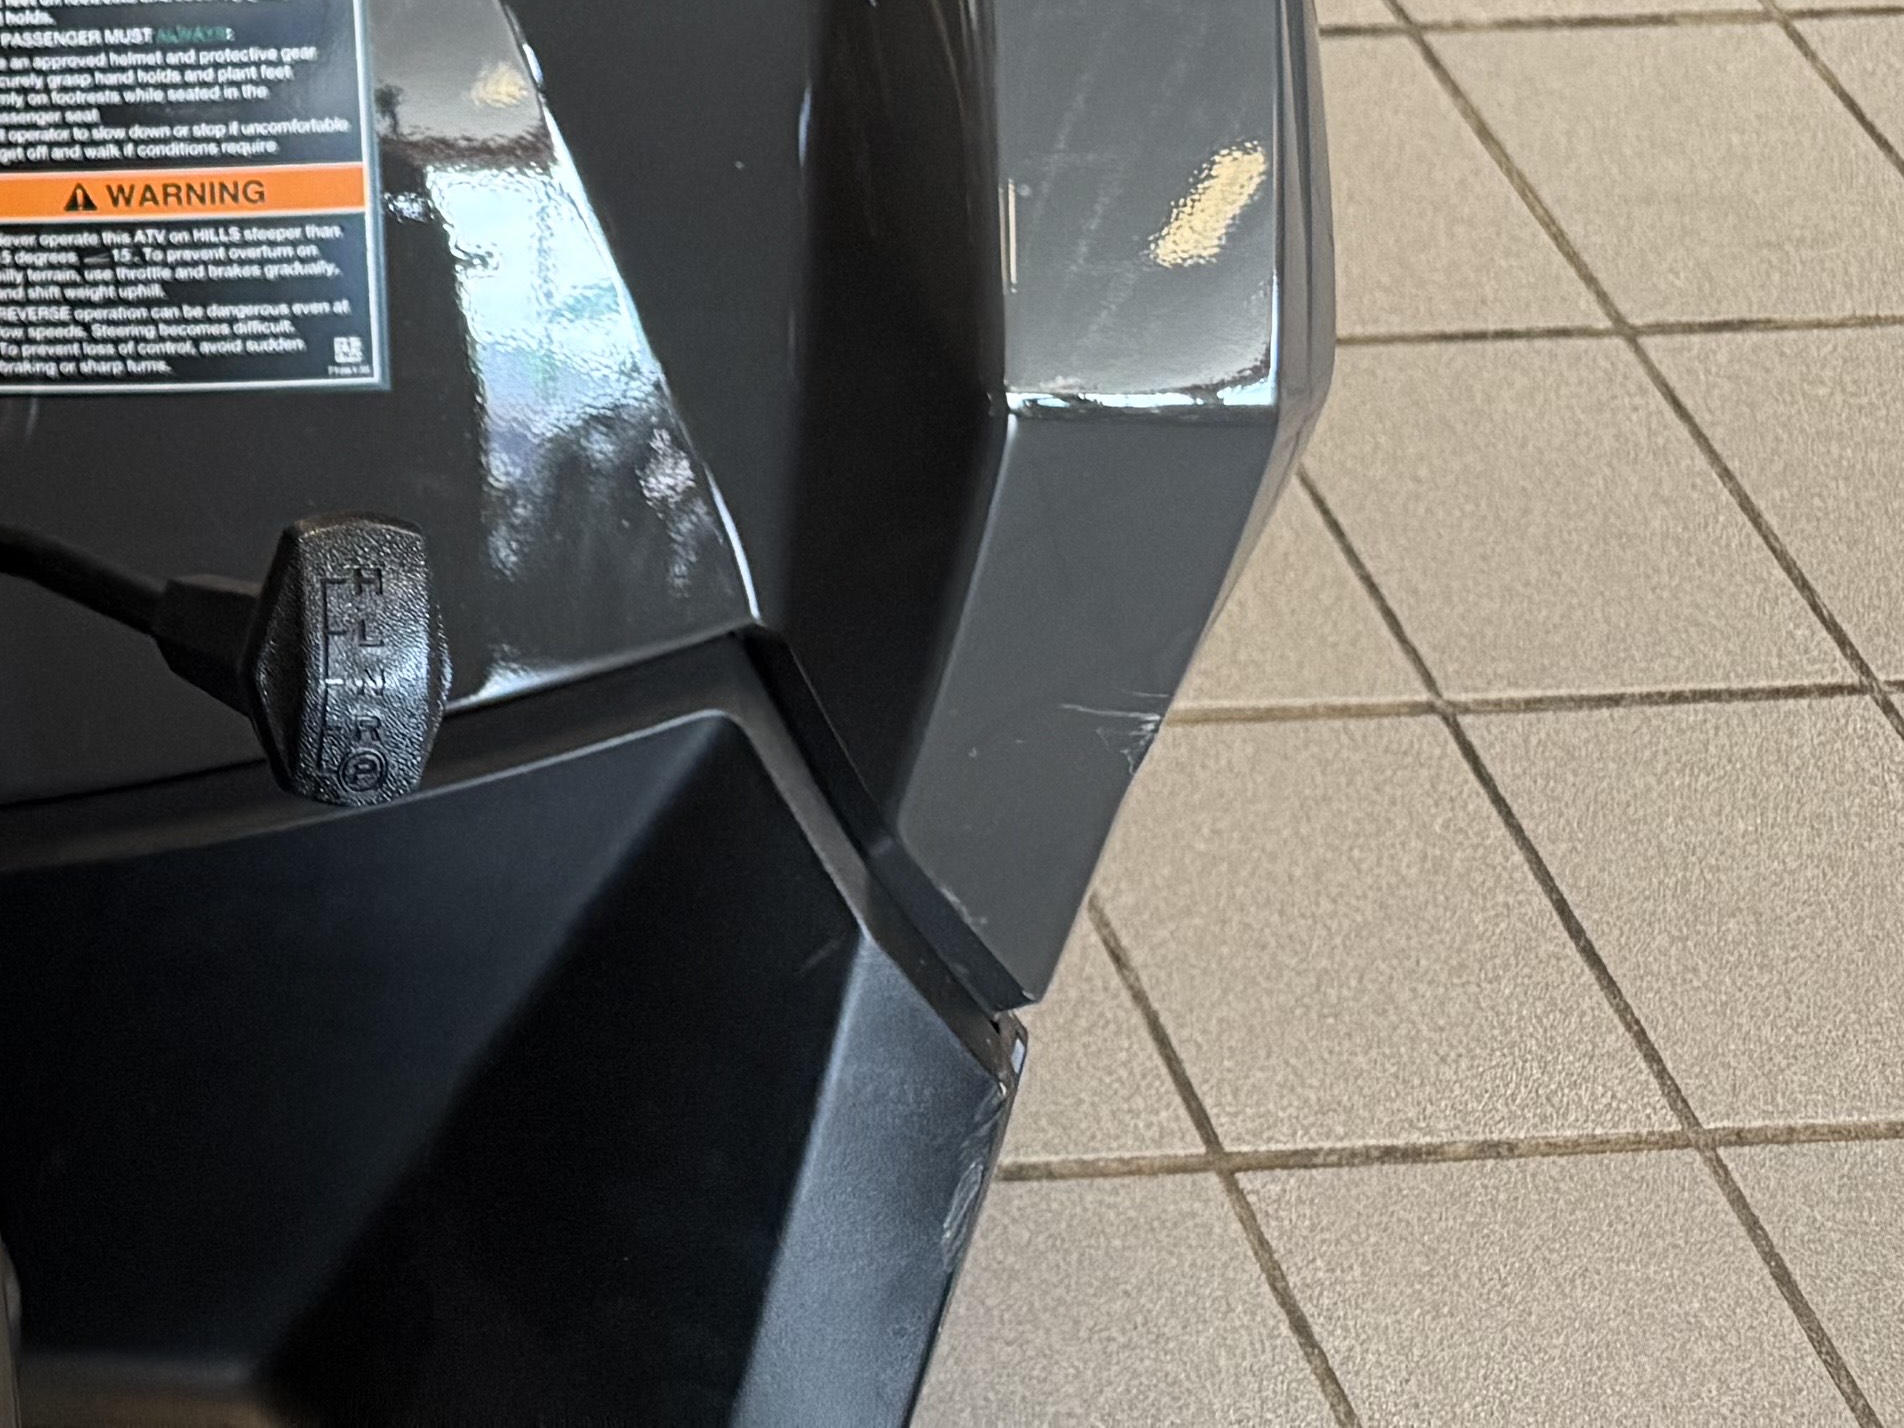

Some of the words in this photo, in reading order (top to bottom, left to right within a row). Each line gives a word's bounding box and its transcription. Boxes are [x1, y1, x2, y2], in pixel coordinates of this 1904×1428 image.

[0, 29, 102, 47] PASSENGER
[104, 26, 152, 44] MUST
[105, 180, 265, 207] WARNING
[358, 619, 384, 647] L
[354, 714, 381, 743] R
